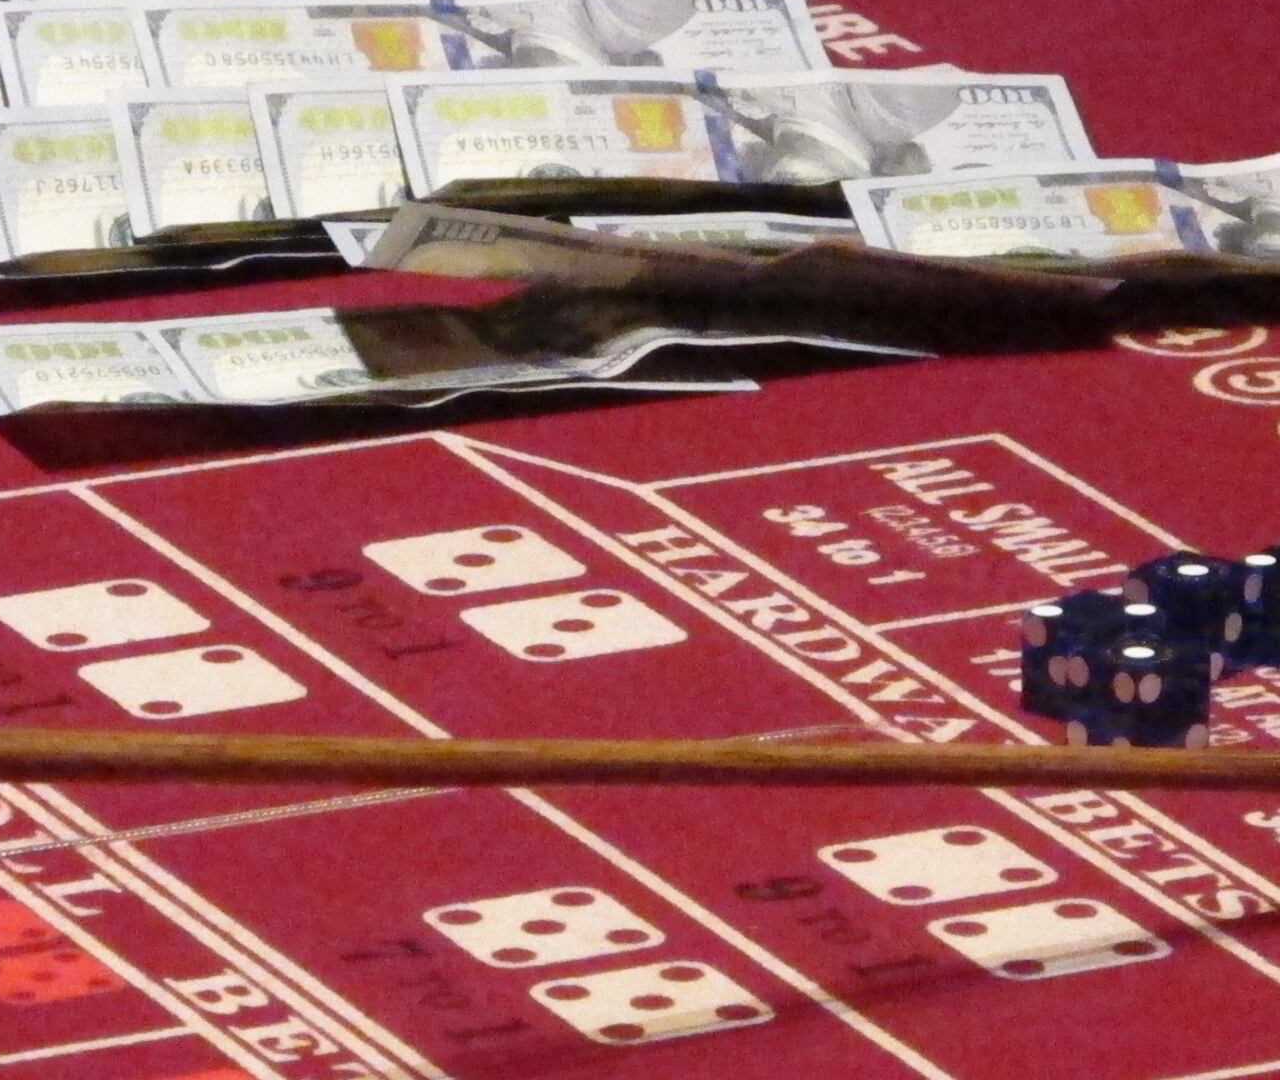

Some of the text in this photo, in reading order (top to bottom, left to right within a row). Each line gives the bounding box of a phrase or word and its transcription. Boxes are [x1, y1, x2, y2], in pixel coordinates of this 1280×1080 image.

[763, 504, 927, 585] 34 to 1
[869, 457, 1128, 587] ALL SMALL
[616, 524, 1275, 920] HARDWA BETS
